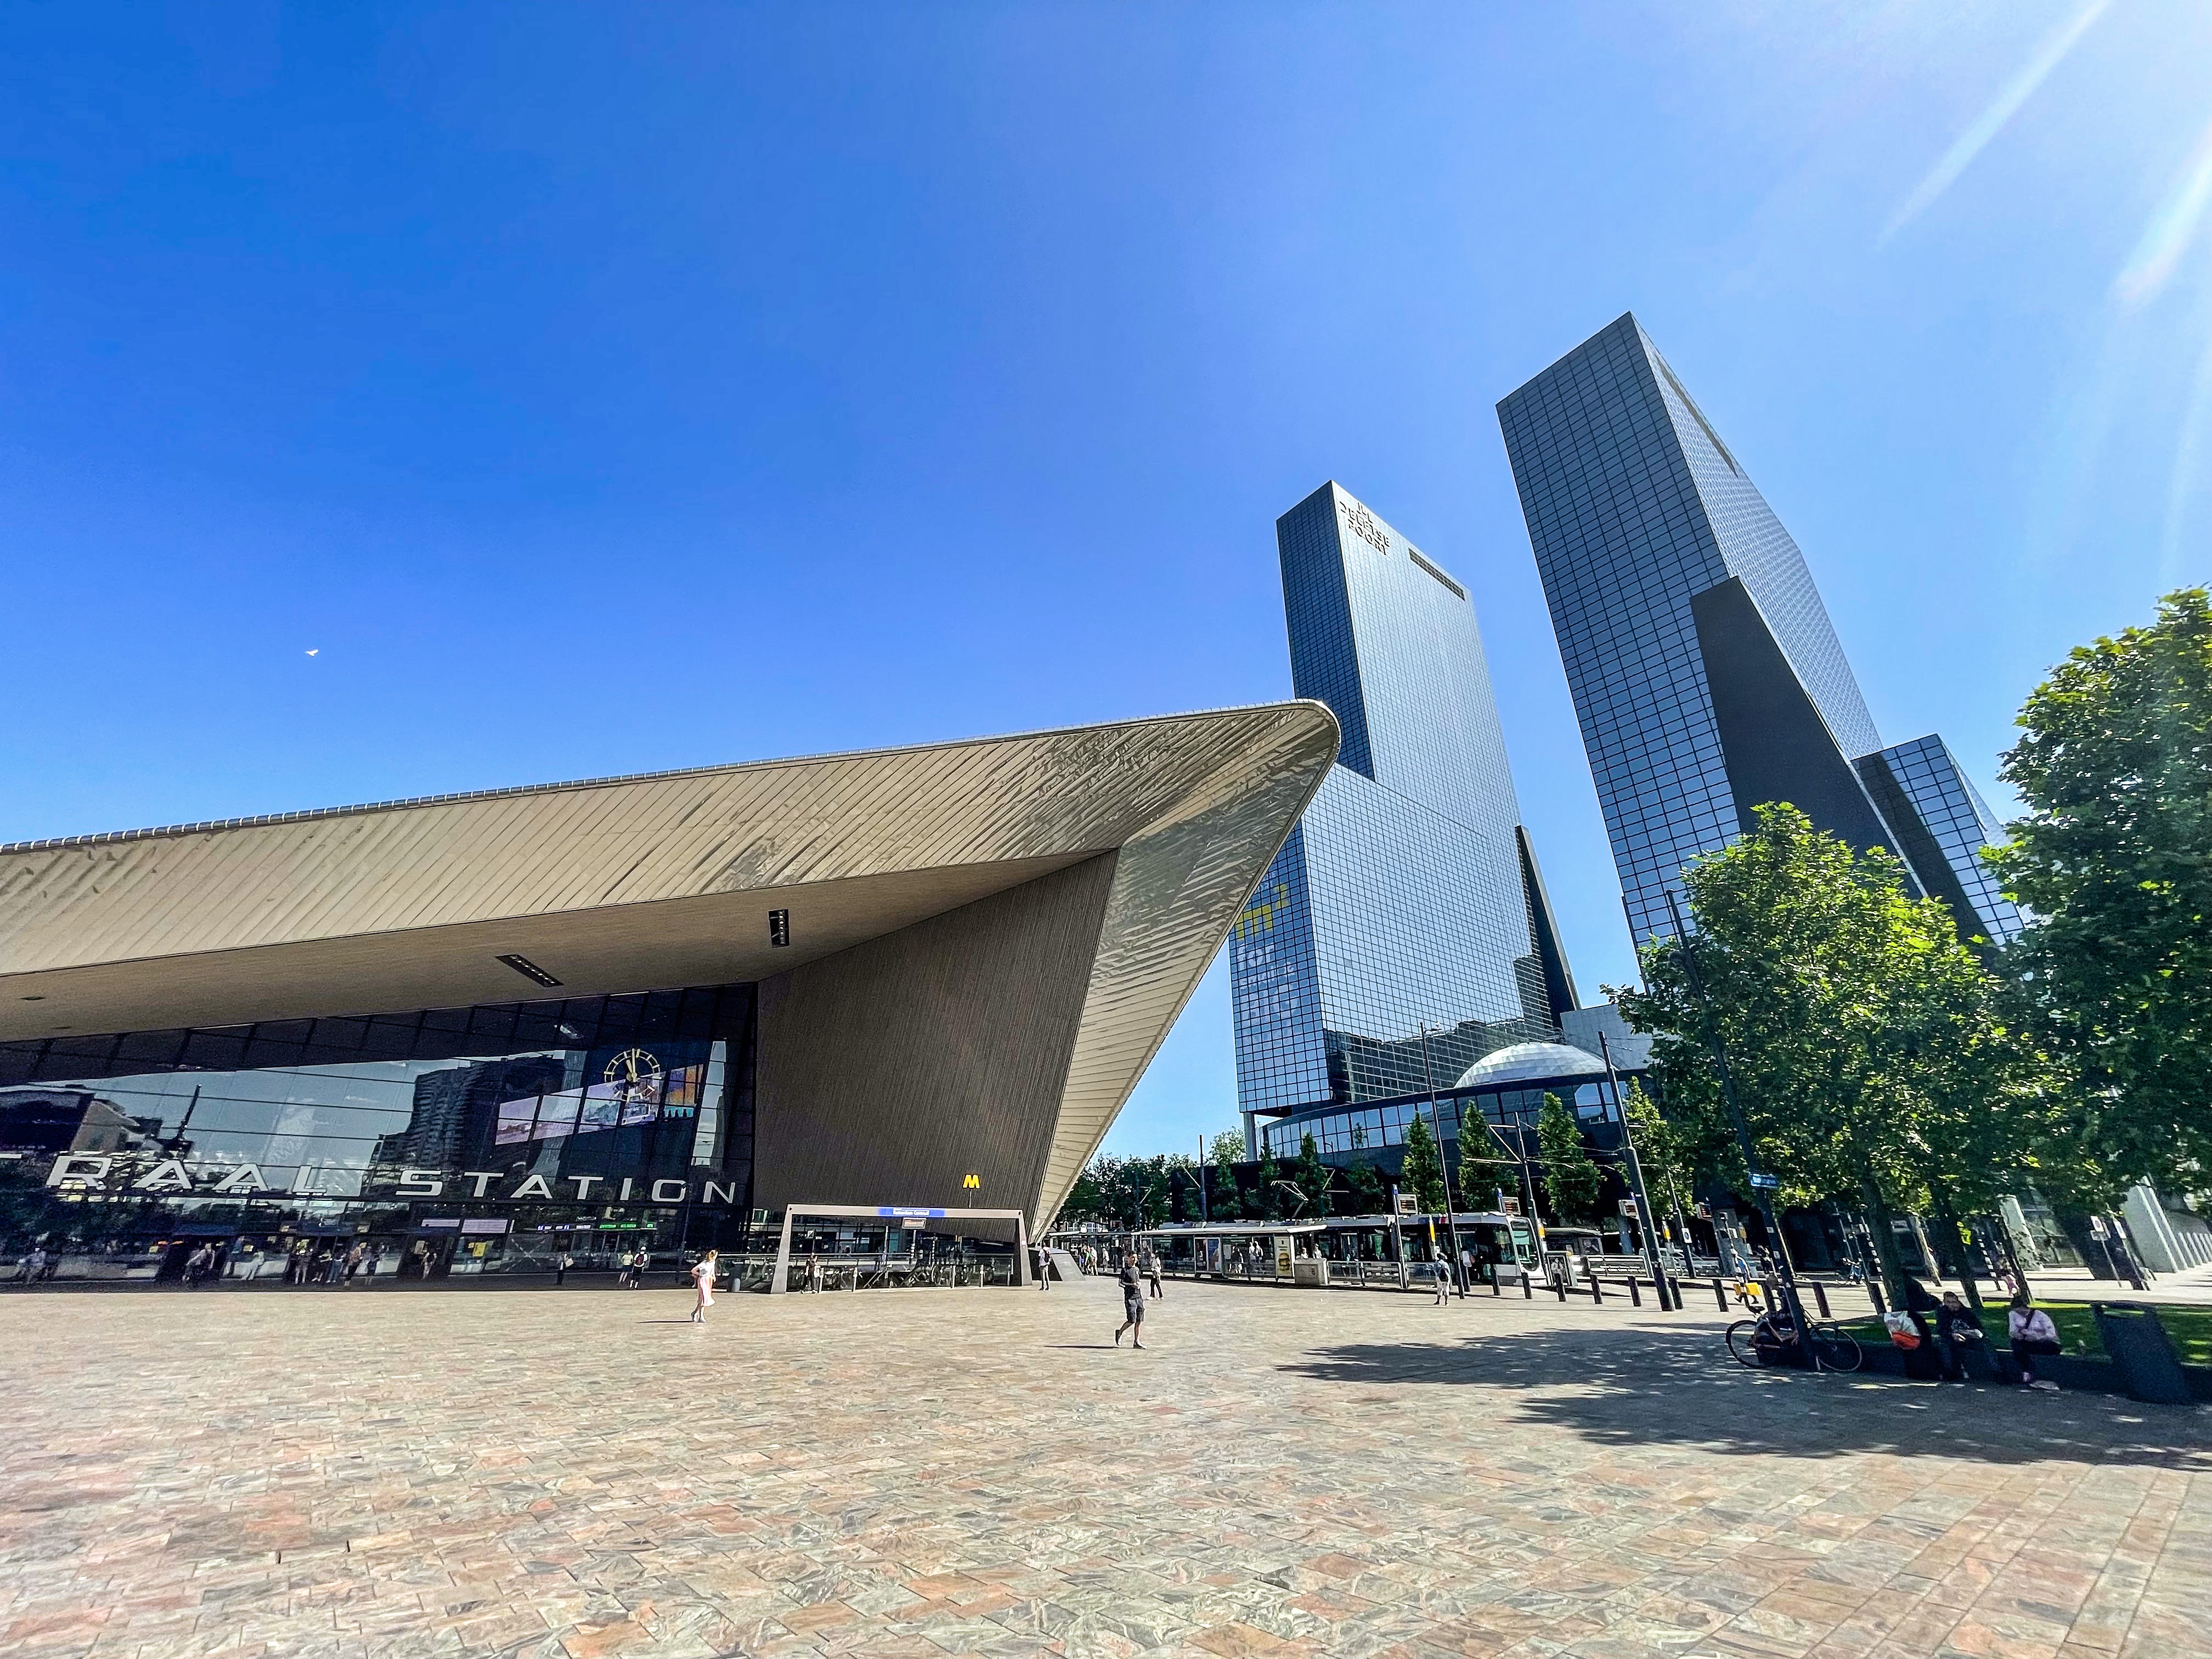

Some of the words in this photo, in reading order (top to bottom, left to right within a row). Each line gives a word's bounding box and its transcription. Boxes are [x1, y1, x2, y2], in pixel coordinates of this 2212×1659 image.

[1340, 501, 1390, 548] DELFTSE
[1347, 518, 1388, 556] POORT
[1237, 943, 1275, 971] for
[0, 1153, 328, 1197] RAAL
[395, 1170, 736, 1204] STATION
[963, 1174, 980, 1189] M
